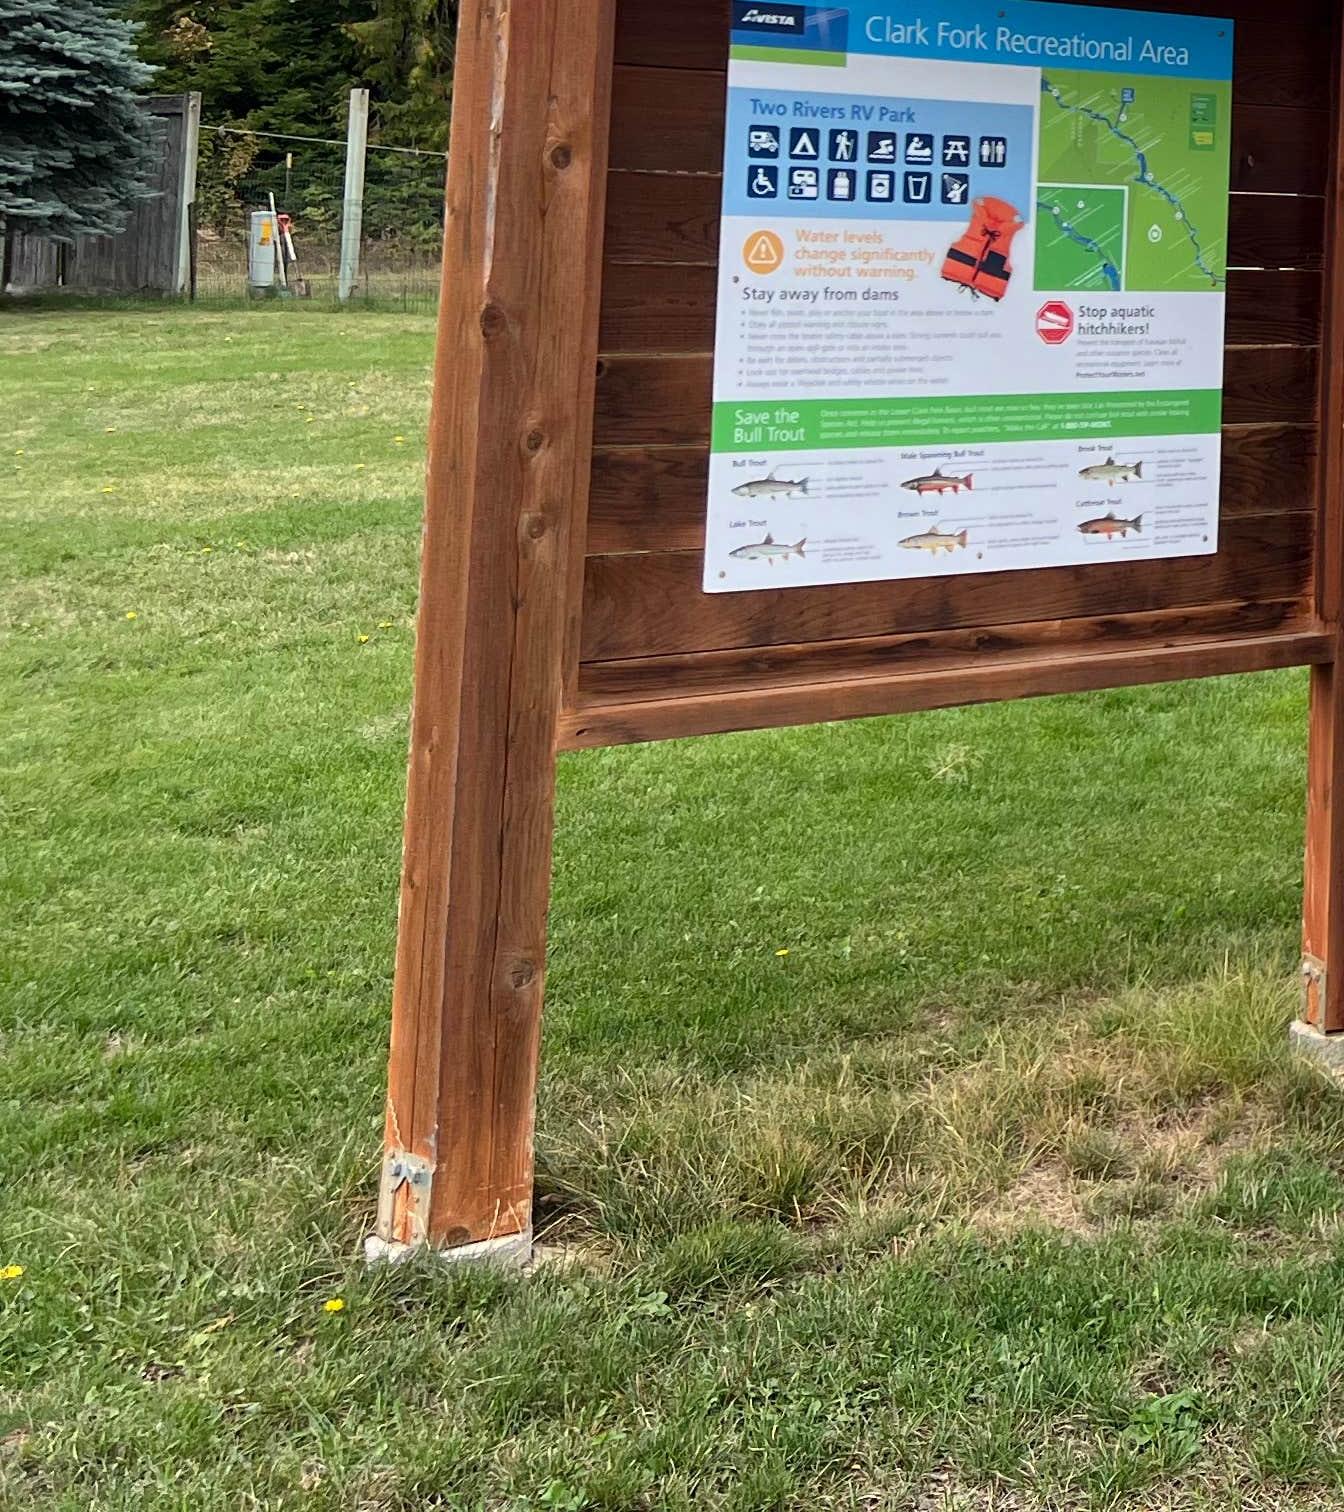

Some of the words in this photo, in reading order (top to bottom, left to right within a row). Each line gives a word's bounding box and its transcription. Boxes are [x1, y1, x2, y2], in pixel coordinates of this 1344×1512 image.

[865, 15, 929, 45] Clark
[937, 22, 988, 50] Fork
[996, 26, 1132, 61] Recreational
[1139, 39, 1189, 66] Area
[750, 98, 787, 117] Two
[792, 100, 845, 120] Rivers
[851, 104, 874, 121] RV
[879, 106, 916, 123] Park
[795, 229, 839, 244] Water
[843, 230, 883, 245] levels
[794, 248, 847, 263] change
[850, 248, 935, 265] significantly
[794, 265, 853, 278] without
[856, 266, 918, 281] warning.
[743, 287, 773, 303] Stay
[780, 290, 818, 303] away
[823, 288, 857, 301] from
[862, 288, 899, 301] dams
[1079, 306, 1107, 320] Stop
[1111, 306, 1155, 320] aquatic
[1078, 323, 1150, 335] hitchhikers!
[735, 409, 770, 425] Save
[774, 408, 800, 424] the
[734, 427, 762, 443] Bull
[767, 426, 805, 442] Trout
